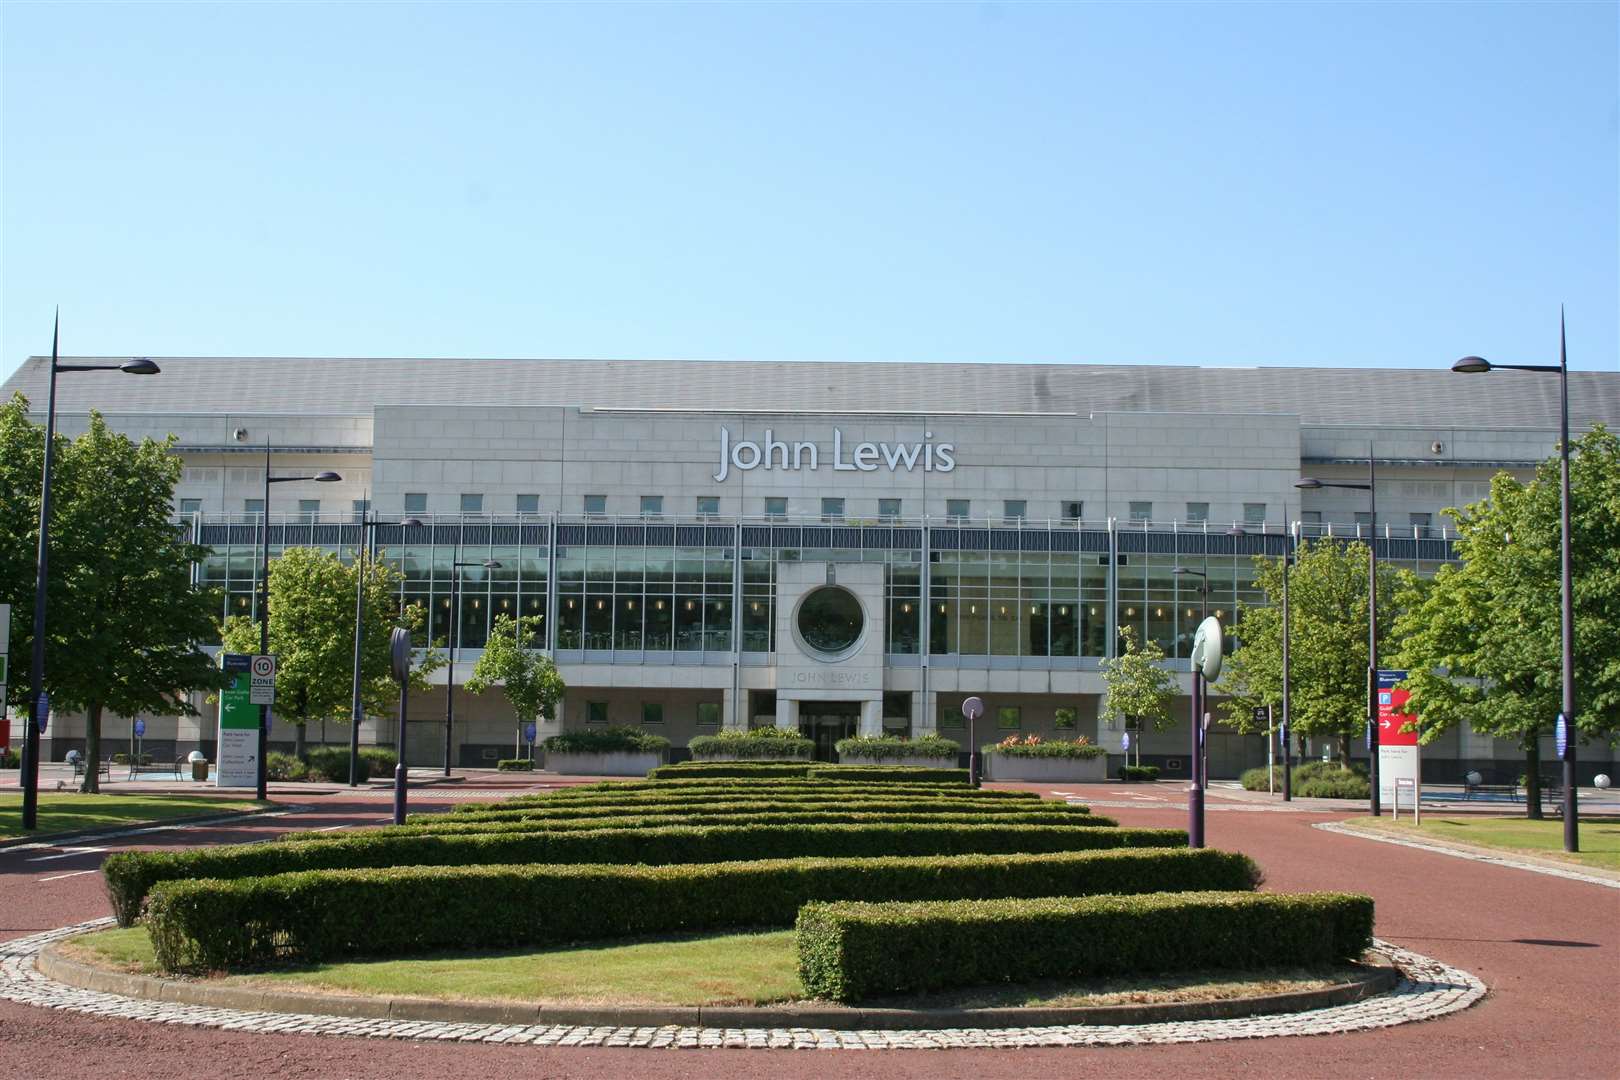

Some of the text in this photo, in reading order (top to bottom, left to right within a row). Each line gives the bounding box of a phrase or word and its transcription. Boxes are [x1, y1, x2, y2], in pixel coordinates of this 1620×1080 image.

[712, 426, 956, 482] John Lewis
[257, 662, 269, 671] 10
[792, 672, 871, 684] JOHN LEWIS
